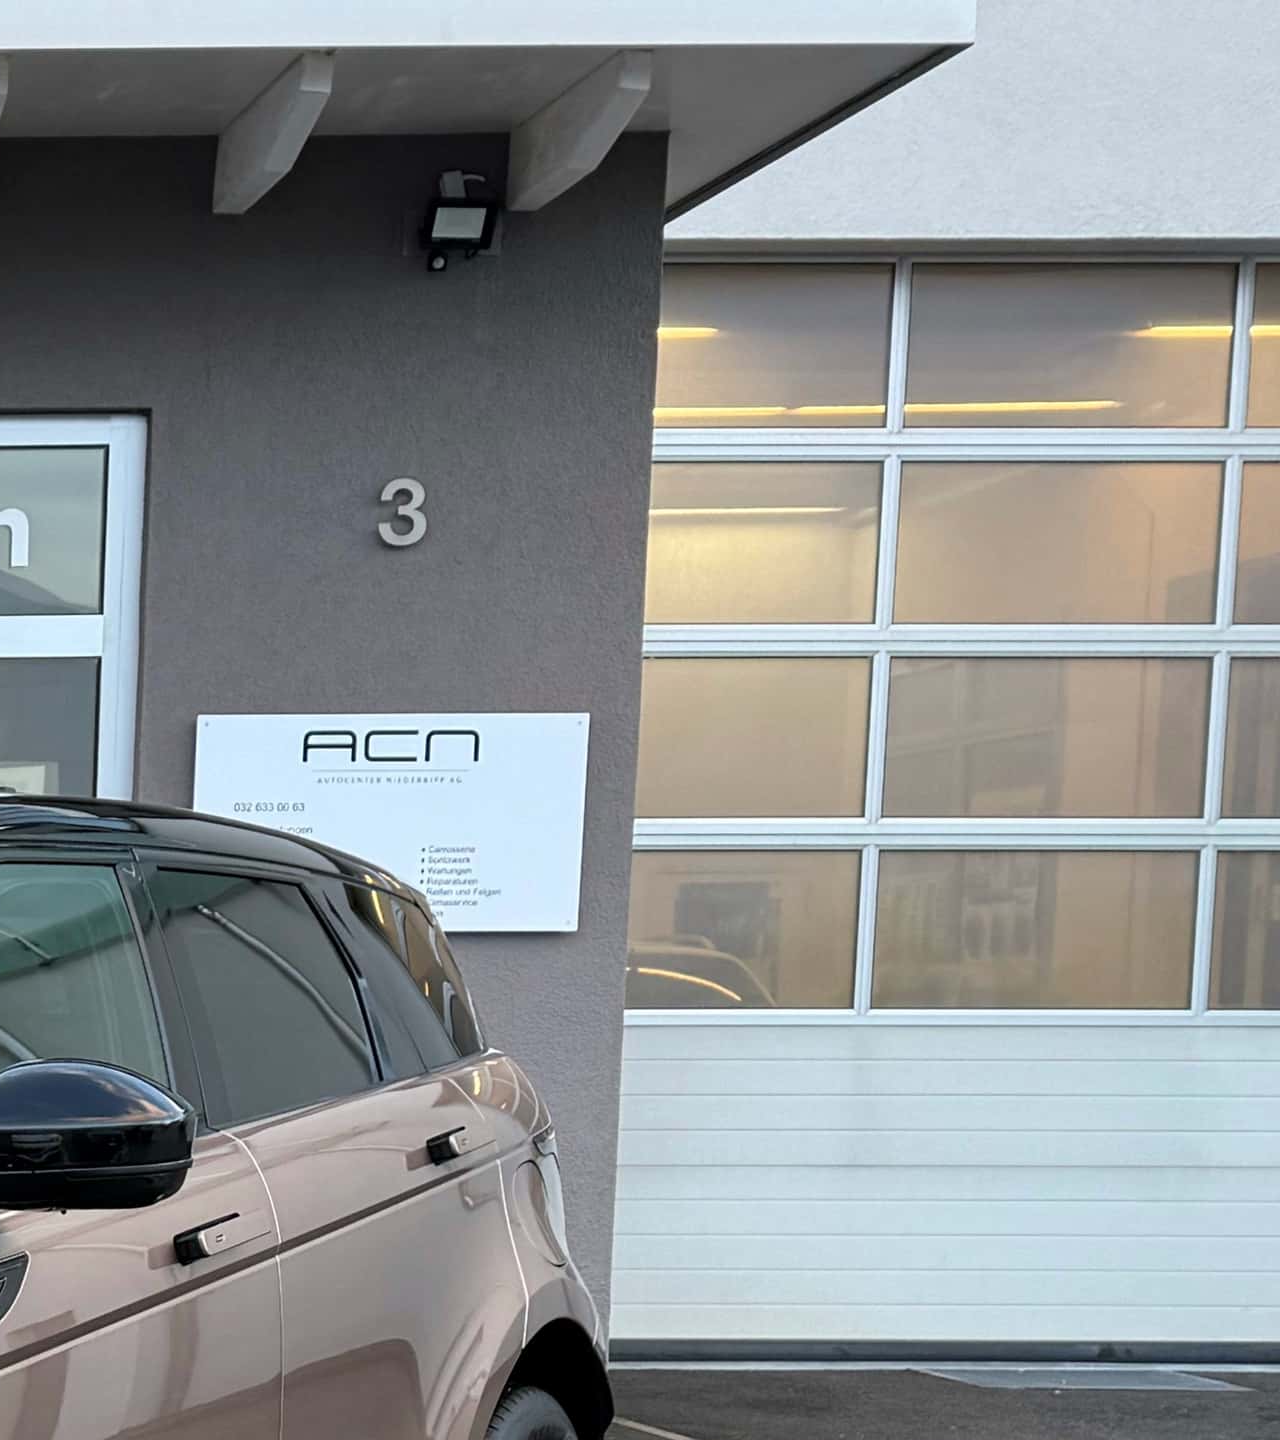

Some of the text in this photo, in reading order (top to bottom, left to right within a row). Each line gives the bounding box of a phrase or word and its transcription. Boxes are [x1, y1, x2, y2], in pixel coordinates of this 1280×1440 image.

[378, 477, 427, 547] 3
[317, 776, 382, 785] AUTOCENTER
[449, 776, 463, 785] AG
[233, 802, 253, 812] 032
[255, 802, 275, 812] 633
